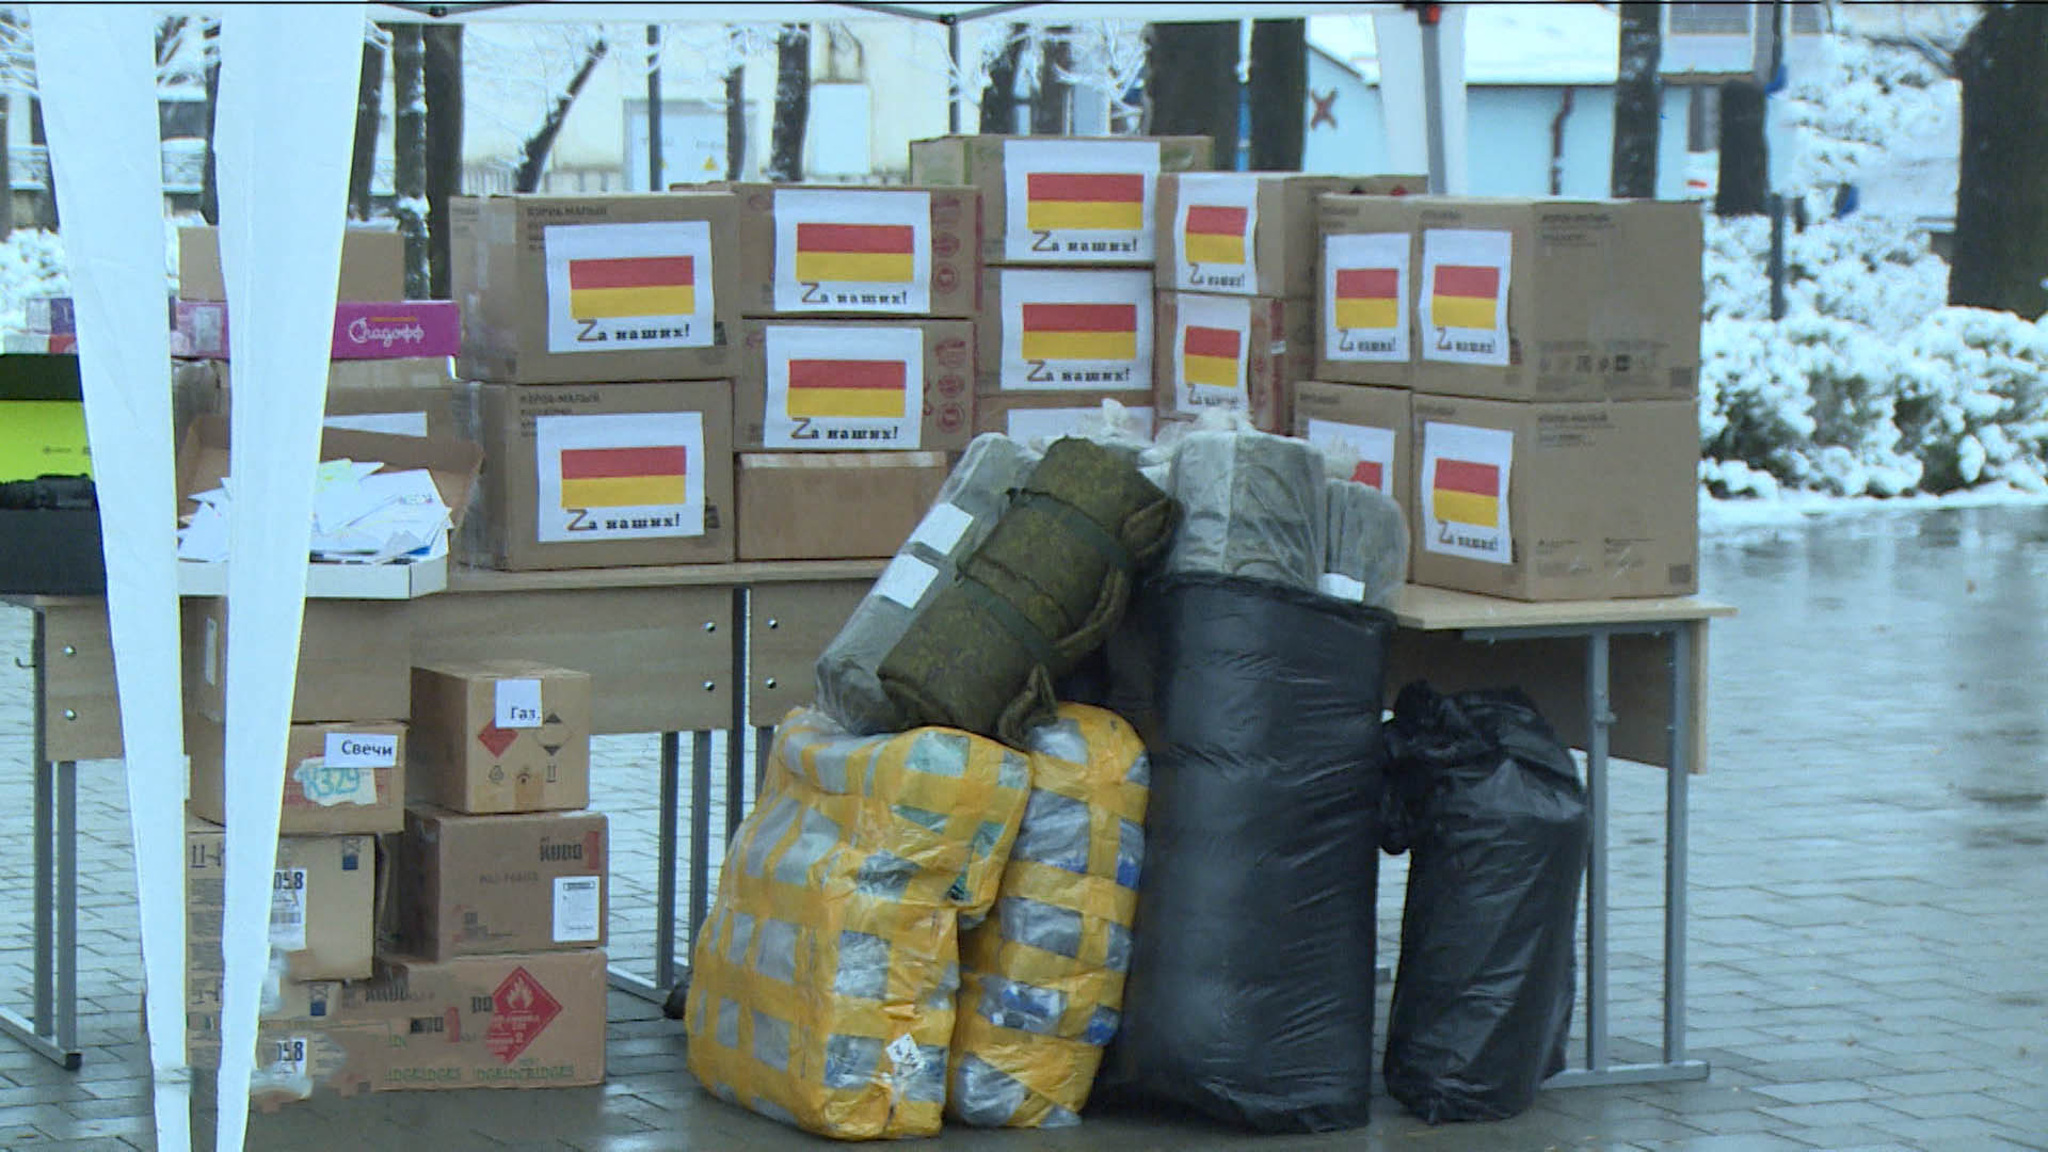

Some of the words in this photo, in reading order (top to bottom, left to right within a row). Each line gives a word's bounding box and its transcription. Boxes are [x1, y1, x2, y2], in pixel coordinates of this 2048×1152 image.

[1067, 238, 1137, 252] наших!
[836, 292, 907, 305] наших!
[615, 324, 690, 341] наших!
[1061, 368, 1130, 382] наших!
[827, 427, 898, 440] наших!
[606, 513, 680, 530] наших!
[341, 740, 393, 756] Свечи
